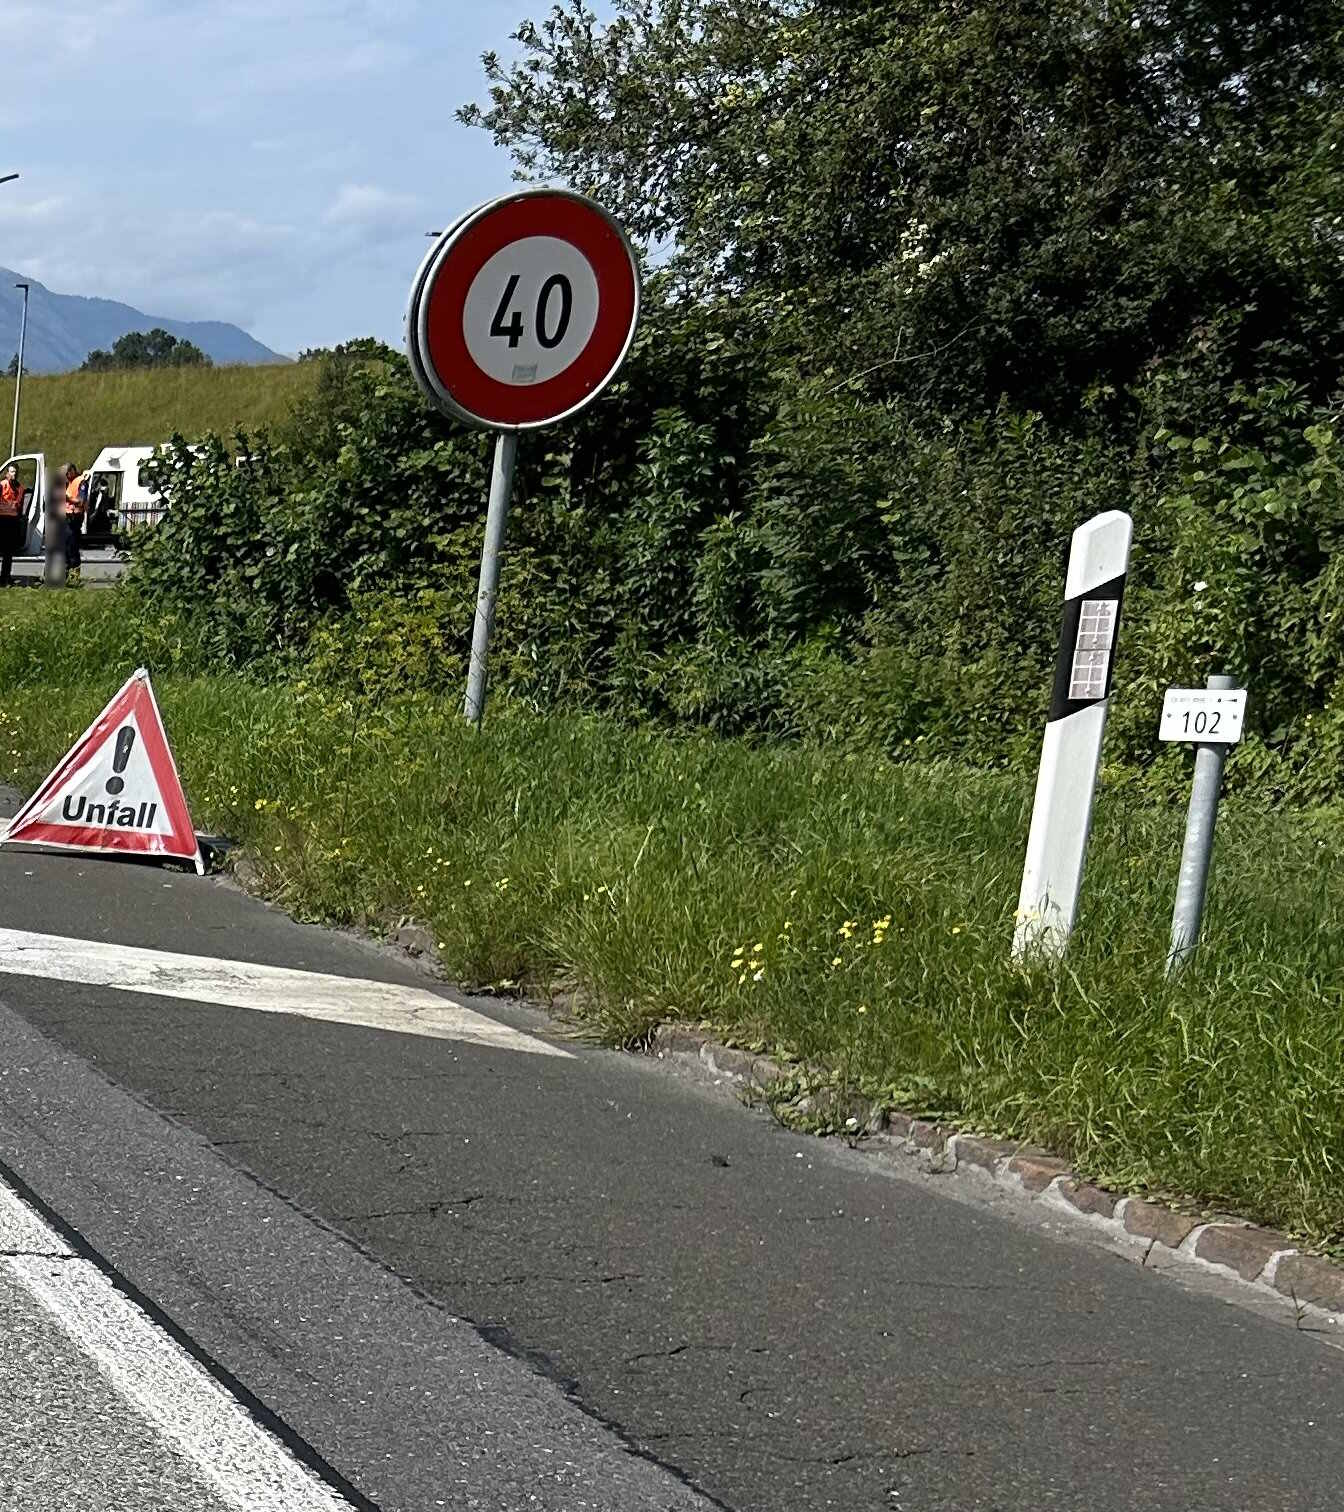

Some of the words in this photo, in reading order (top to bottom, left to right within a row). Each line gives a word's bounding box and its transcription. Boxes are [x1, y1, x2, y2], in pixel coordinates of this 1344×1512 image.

[489, 273, 573, 349] 40
[1182, 711, 1221, 734] 102
[62, 794, 158, 829] Unfall
